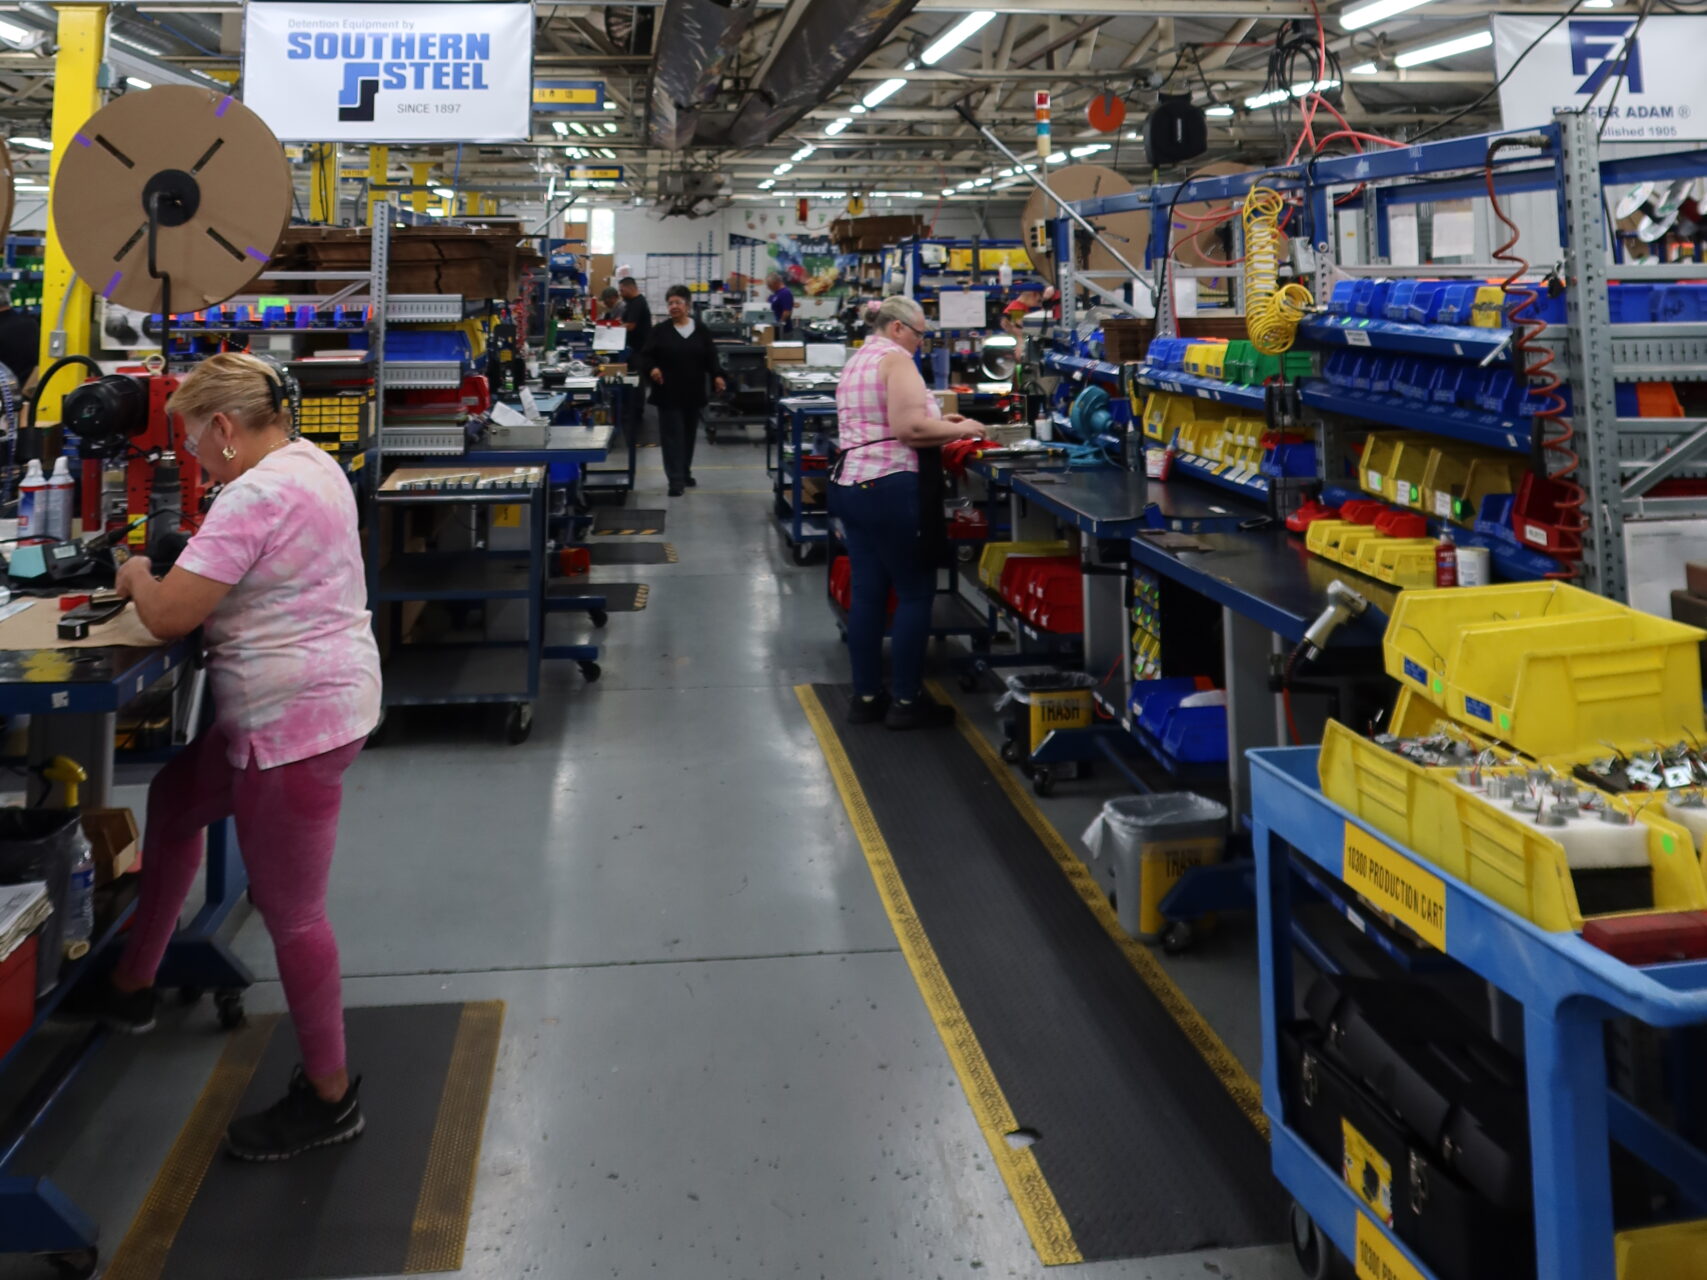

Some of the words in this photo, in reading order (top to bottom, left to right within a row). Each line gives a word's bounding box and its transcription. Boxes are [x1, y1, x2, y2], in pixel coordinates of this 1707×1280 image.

[287, 18, 340, 29] Detention
[342, 18, 399, 31] Equipment
[402, 19, 415, 31] by
[287, 32, 490, 60] SOUTHERN
[382, 61, 489, 90] STEEL
[396, 103, 431, 115] SINCE
[434, 103, 462, 115] 1897
[1626, 105, 1675, 119] ADAM
[1648, 125, 1678, 137] 1905
[1040, 698, 1081, 721] TRASH
[1348, 846, 1368, 879] 10300
[1369, 858, 1420, 915] PRODUCTION
[1420, 893, 1444, 931] CART
